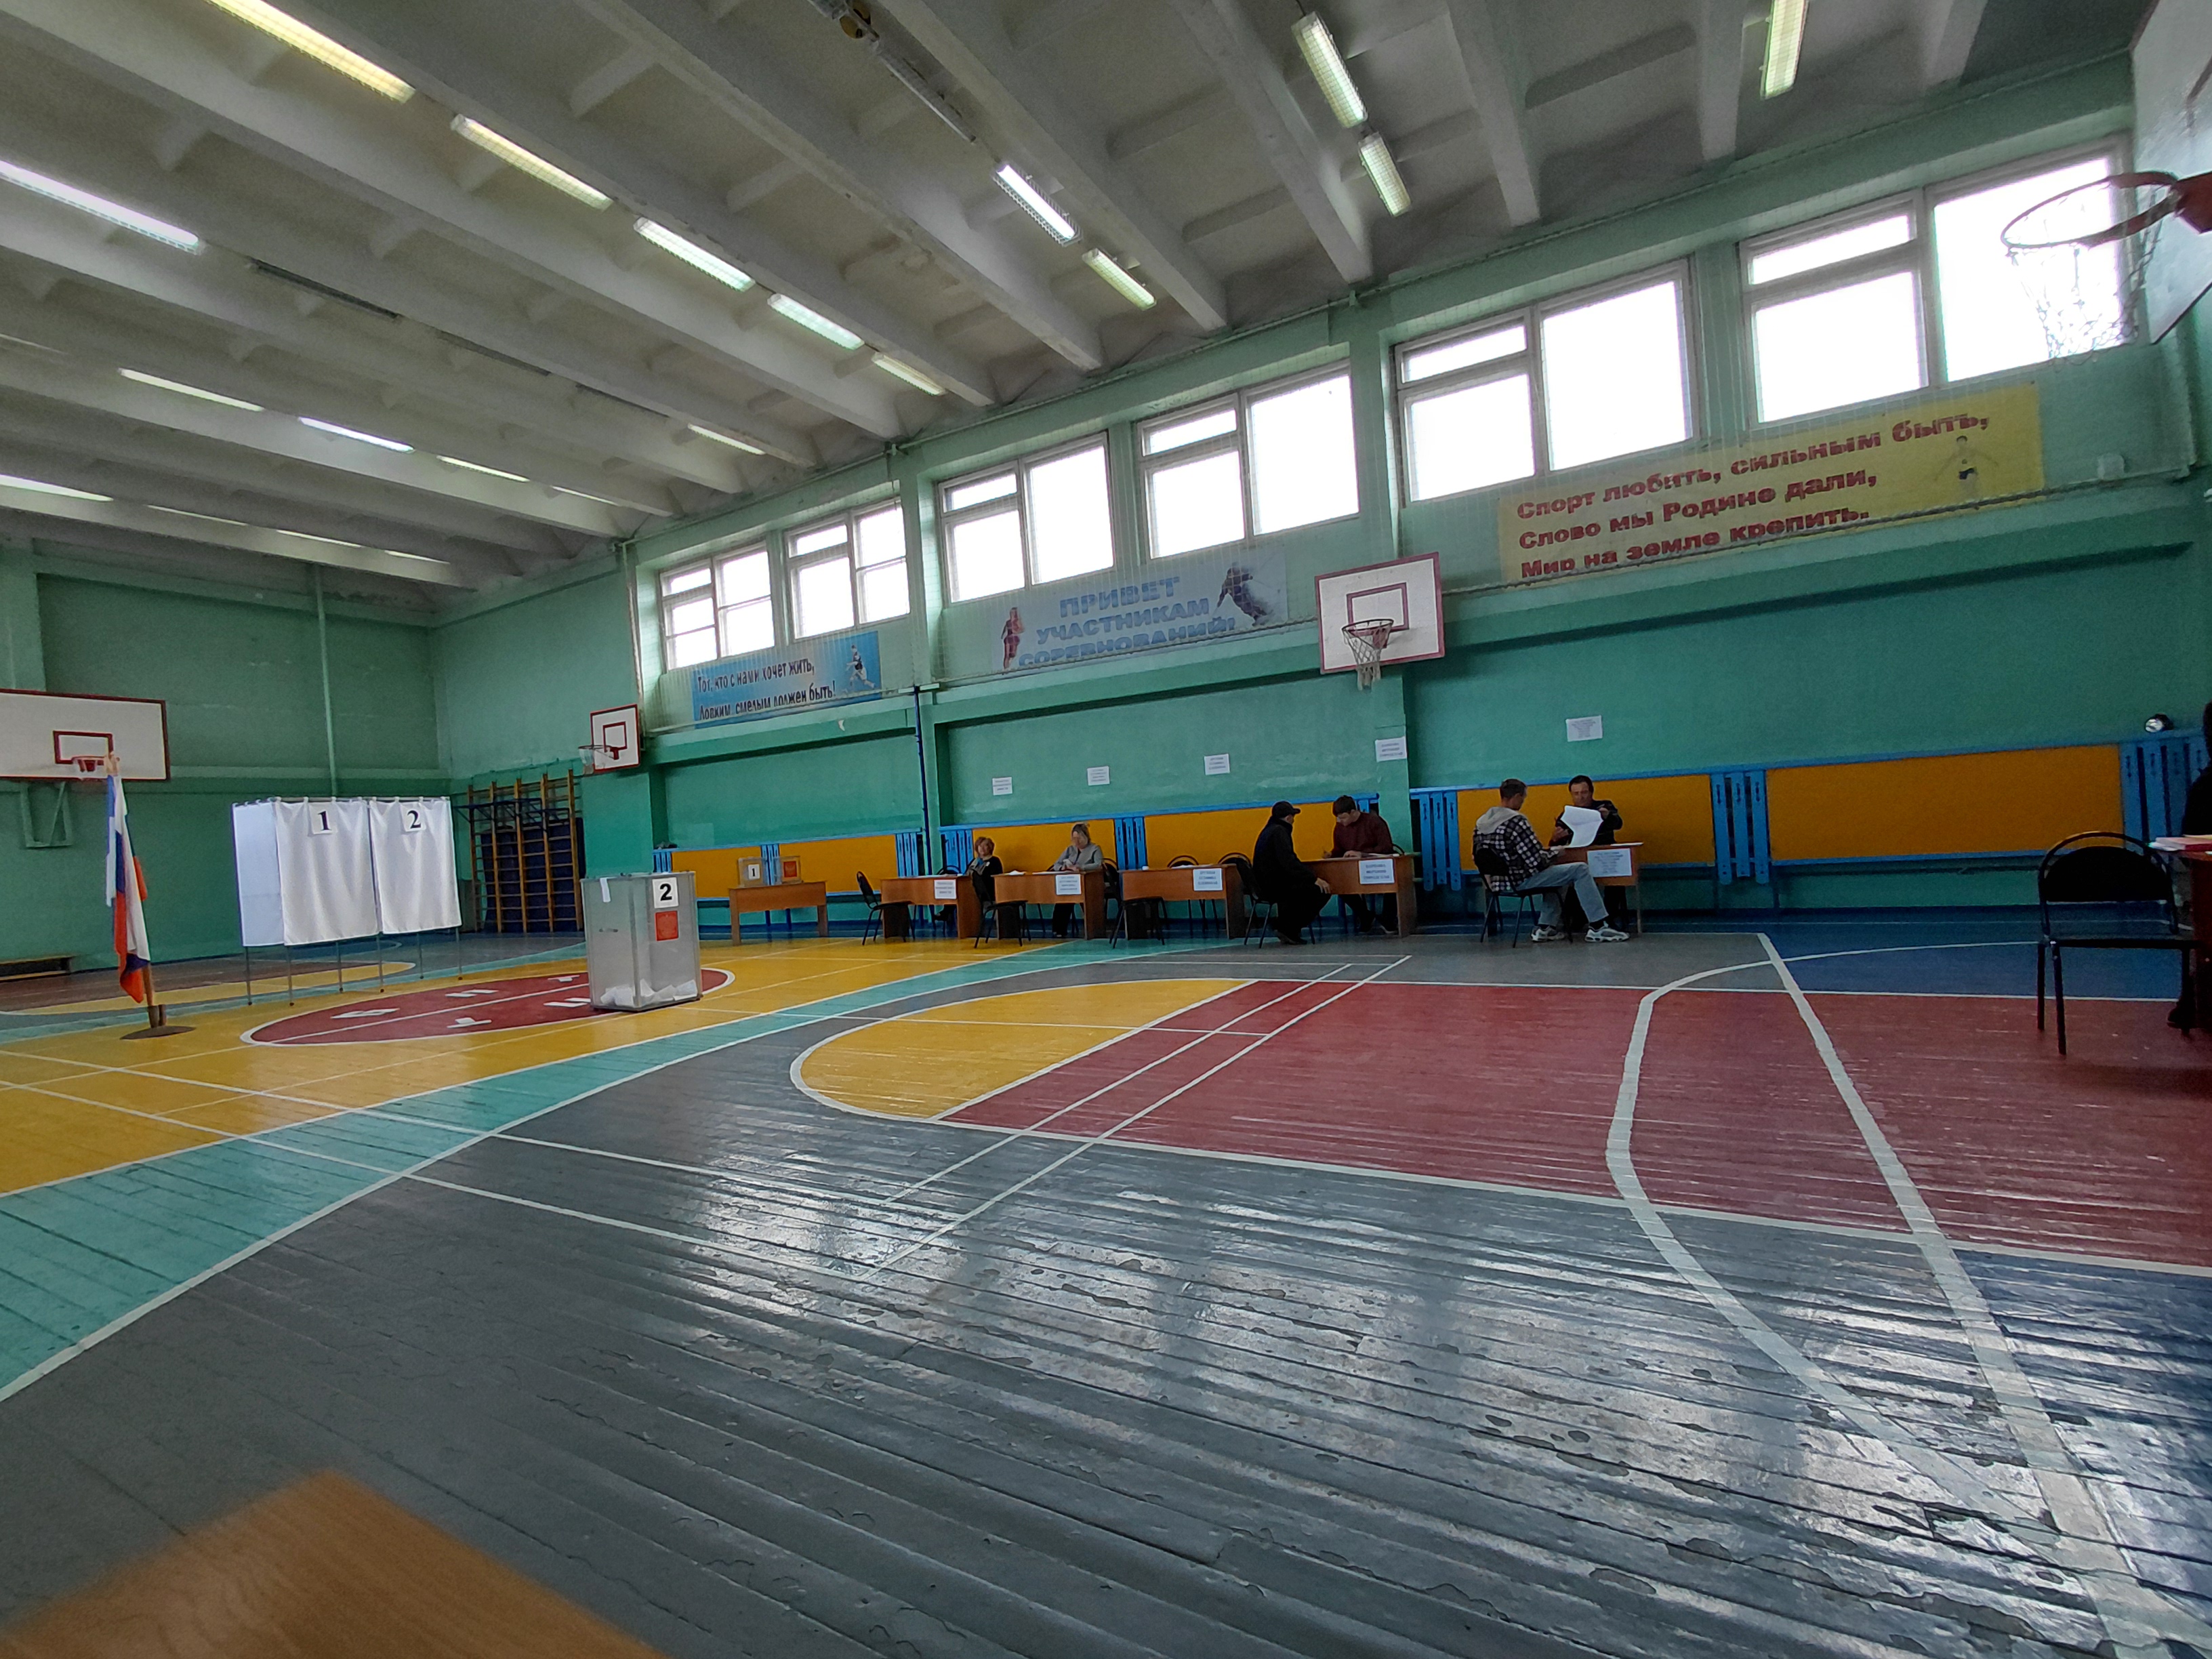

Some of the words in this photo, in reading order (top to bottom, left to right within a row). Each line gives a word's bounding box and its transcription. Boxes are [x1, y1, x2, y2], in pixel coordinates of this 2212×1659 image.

[1517, 492, 1595, 519] Спорт
[1603, 468, 1721, 502] любить,
[1731, 432, 1881, 474] сильным
[1892, 413, 1990, 442] быть,
[1519, 523, 1601, 549] Слово
[1610, 512, 1654, 533] мы
[1663, 487, 1776, 522] Родине
[1785, 470, 1877, 503] дали,
[1521, 558, 1576, 578] Мир
[1584, 550, 1618, 568] на
[1626, 531, 1720, 560] земле
[1730, 507, 1870, 542] крепить.
[1060, 577, 1180, 618] ПРИВЕТ
[1036, 598, 1210, 645] УЧАСТНИКАМ
[698, 676, 713, 693] Тот,
[714, 675, 729, 691] кто
[730, 674, 735, 688] с
[737, 668, 759, 686] нами
[762, 662, 787, 680] хочет
[789, 658, 815, 676] жить,
[735, 697, 771, 714] смелым
[809, 680, 836, 701] быть!
[318, 811, 332, 831] 1
[407, 810, 422, 829] 2
[659, 883, 672, 901] 2
